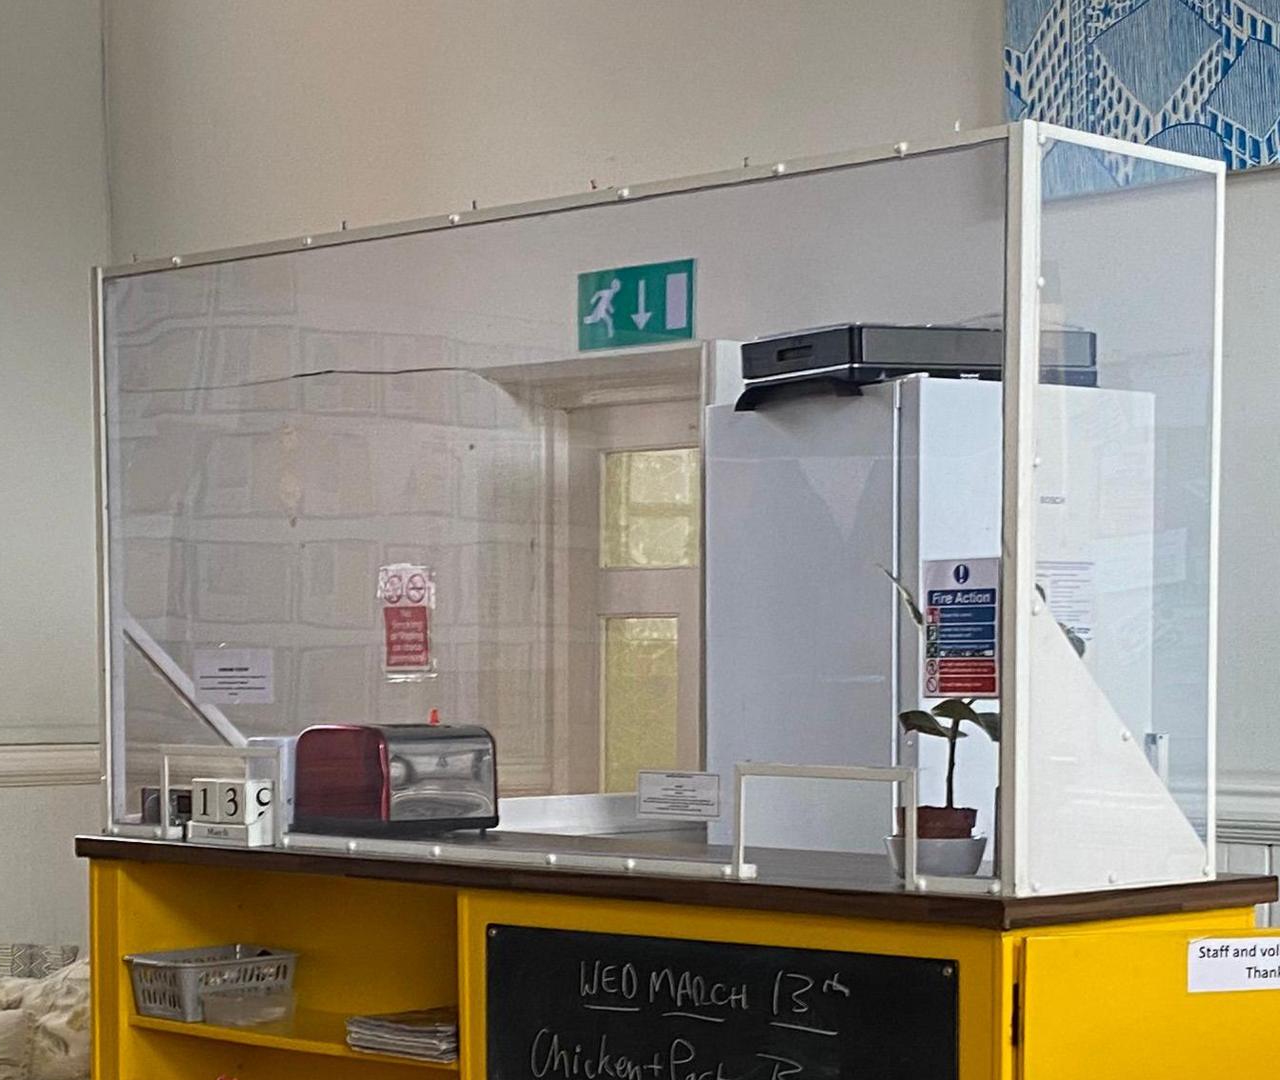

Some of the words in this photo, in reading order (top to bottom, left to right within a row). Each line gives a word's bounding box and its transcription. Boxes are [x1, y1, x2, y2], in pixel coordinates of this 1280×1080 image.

[932, 593, 953, 604] Fire
[955, 592, 991, 603] Action
[207, 828, 228, 836] March
[1198, 945, 1230, 959] Staff
[1233, 945, 1257, 957] and
[580, 959, 639, 1000] WED
[648, 968, 749, 1009] MARCH
